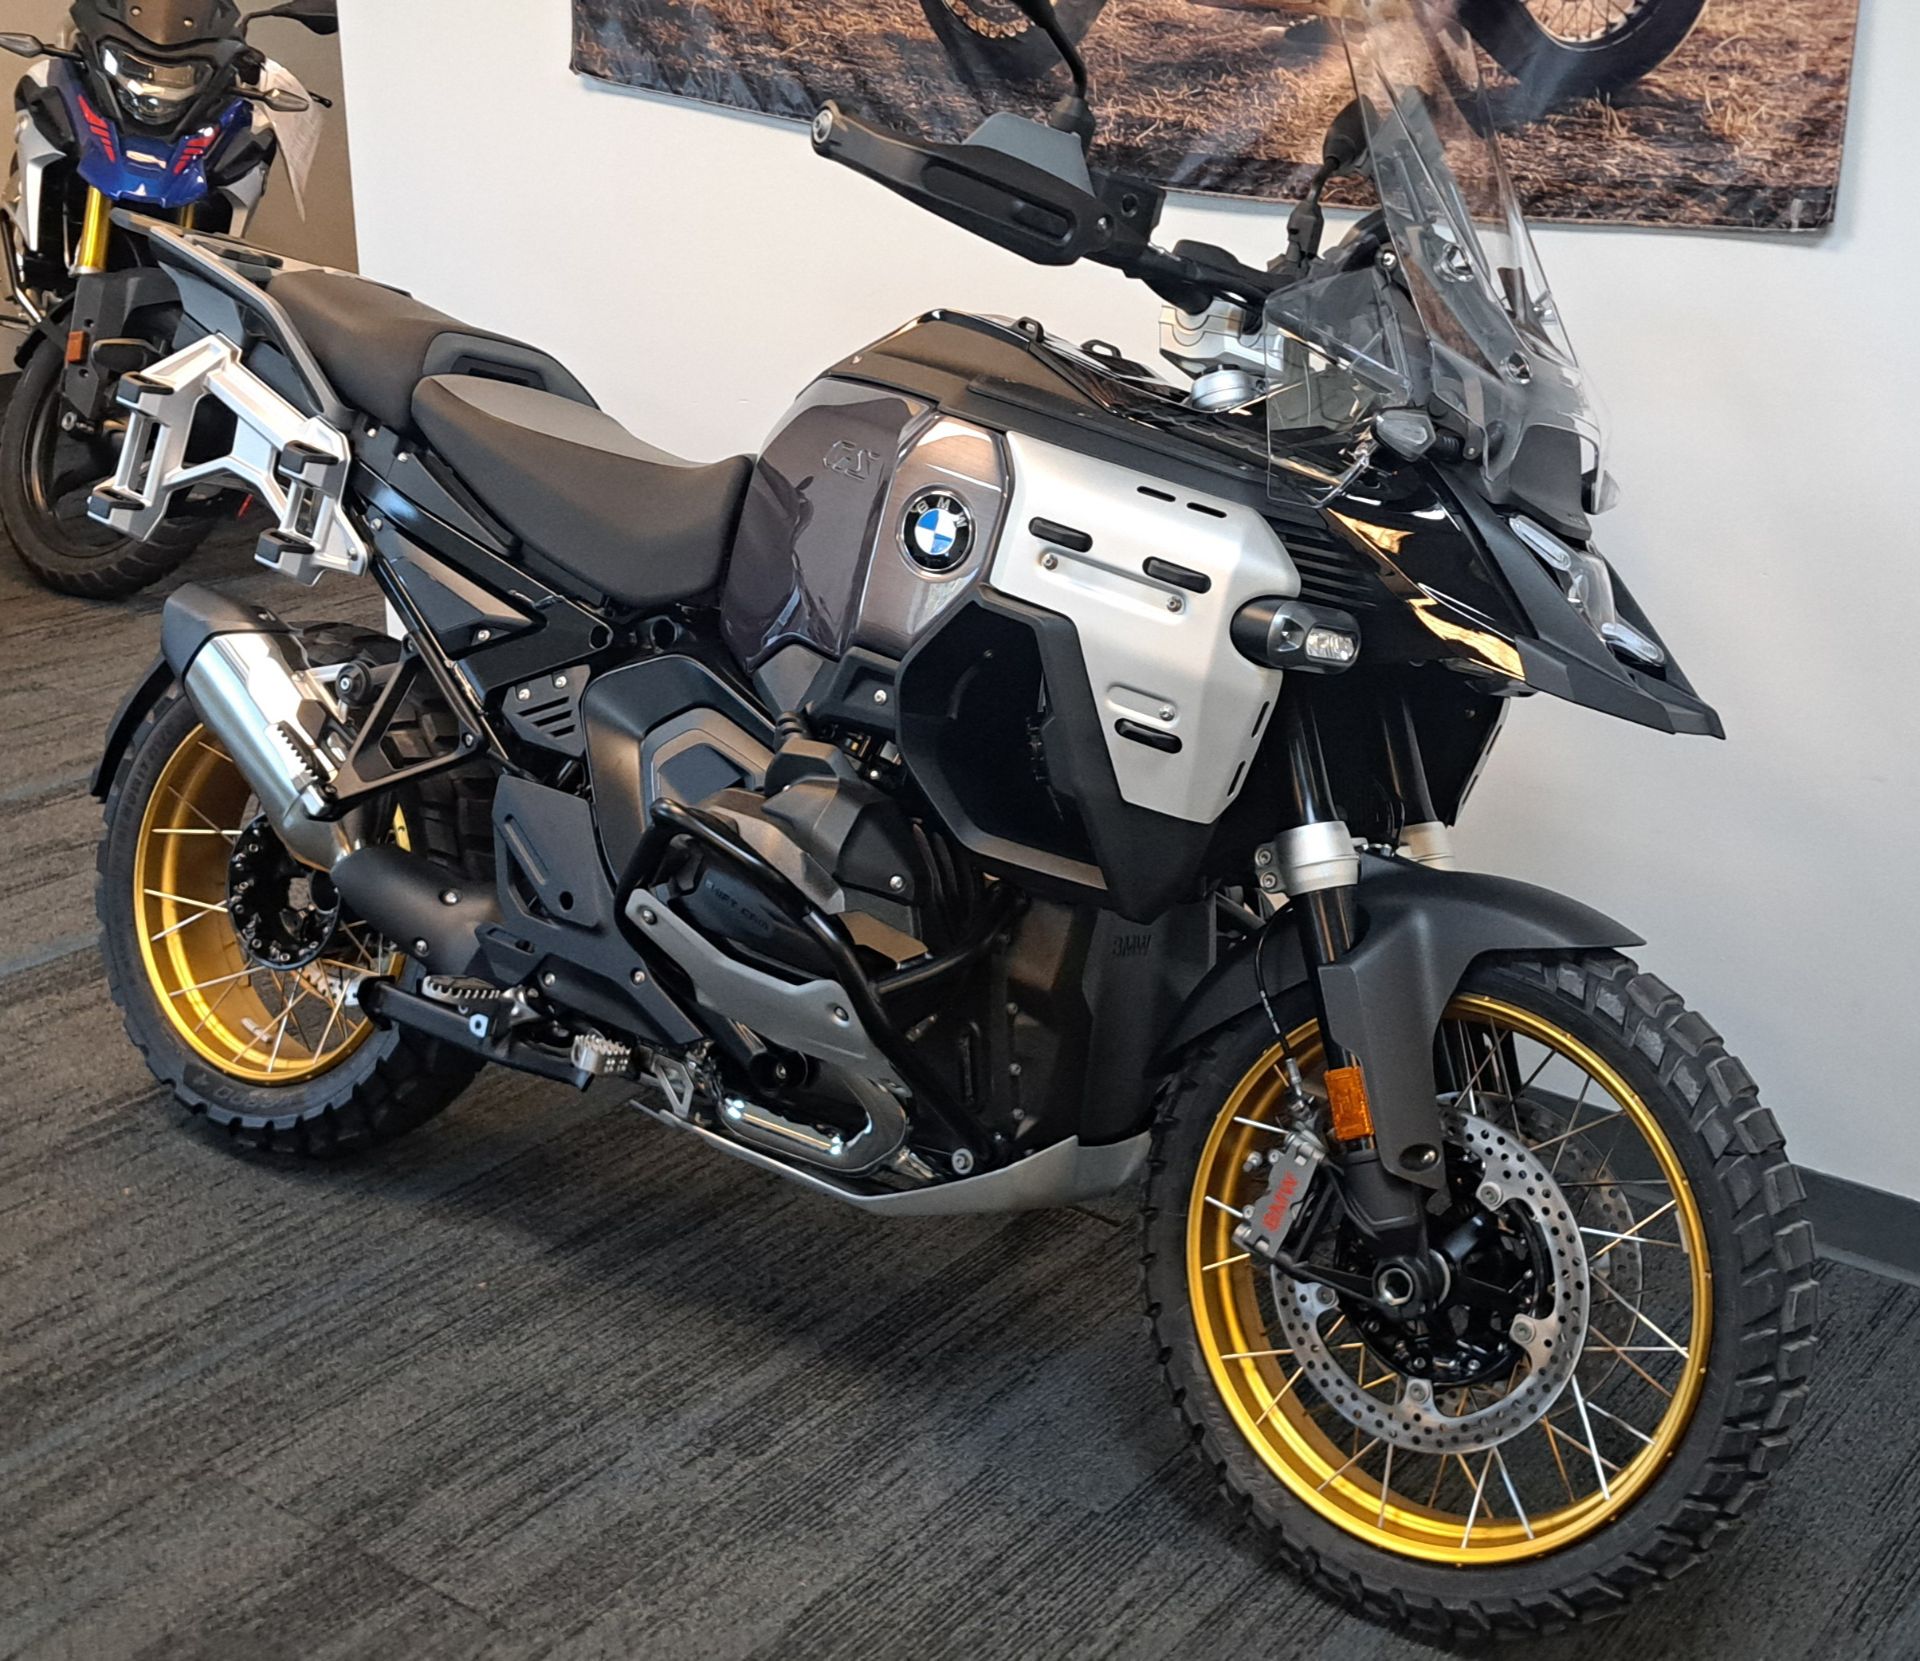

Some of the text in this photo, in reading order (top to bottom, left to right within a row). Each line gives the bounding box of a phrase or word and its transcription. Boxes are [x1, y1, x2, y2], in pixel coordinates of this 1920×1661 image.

[823, 439, 881, 480] GS
[914, 496, 968, 528] BMW
[1112, 934, 1153, 957] BMW
[1263, 1169, 1299, 1233] BMW
